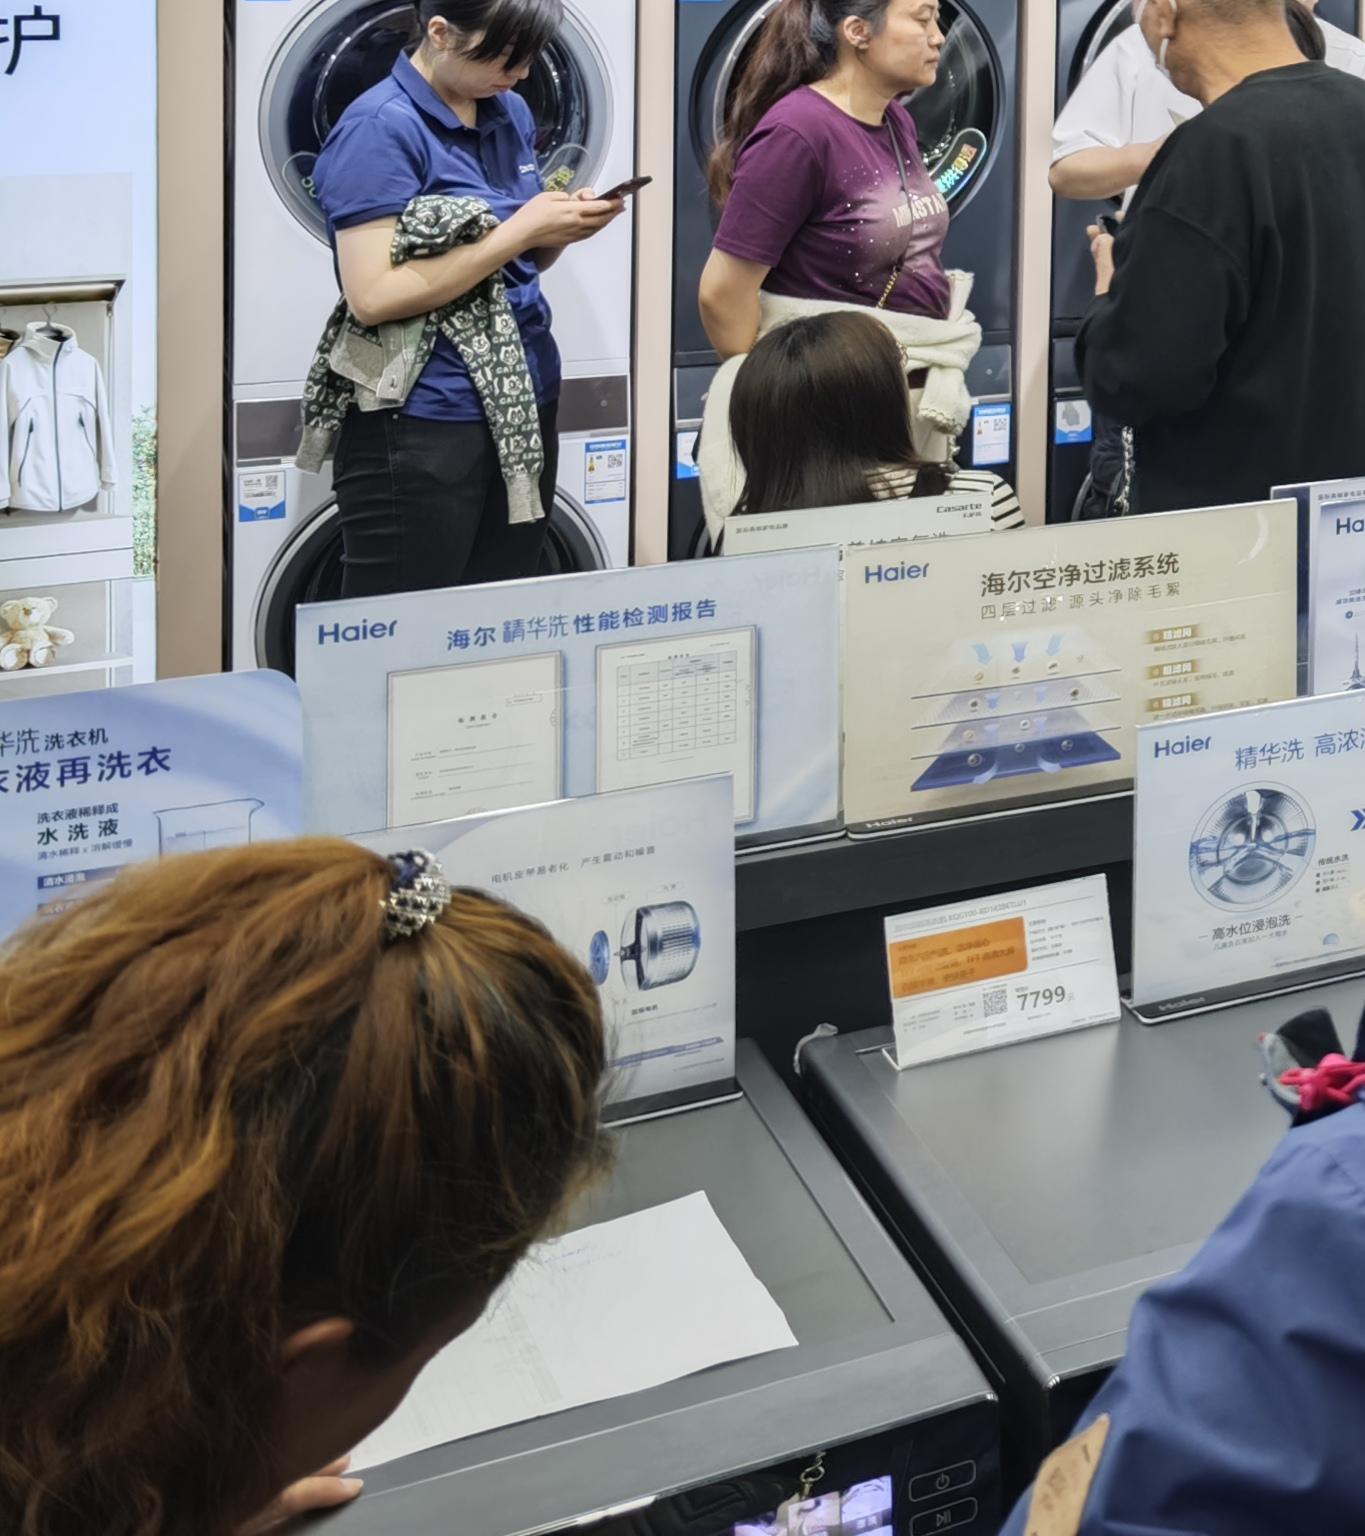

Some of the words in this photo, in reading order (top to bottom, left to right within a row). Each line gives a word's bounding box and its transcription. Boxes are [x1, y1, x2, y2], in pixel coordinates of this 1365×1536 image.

[935, 502, 983, 514] Casarte
[864, 560, 930, 585] Haier
[980, 551, 1181, 598] 海尔空净过滤系统
[1069, 581, 1182, 610] 源头净除毛絮
[317, 620, 398, 646] Haier
[1154, 735, 1213, 759] Haier
[1234, 738, 1305, 772] 精华洗
[0, 745, 173, 794] 液再洗衣
[36, 802, 120, 825] 洗衣液稀释成
[36, 818, 120, 846] 水洗液
[1210, 913, 1292, 942] 高水位浸泡洗
[1016, 985, 1066, 1011] 7799
